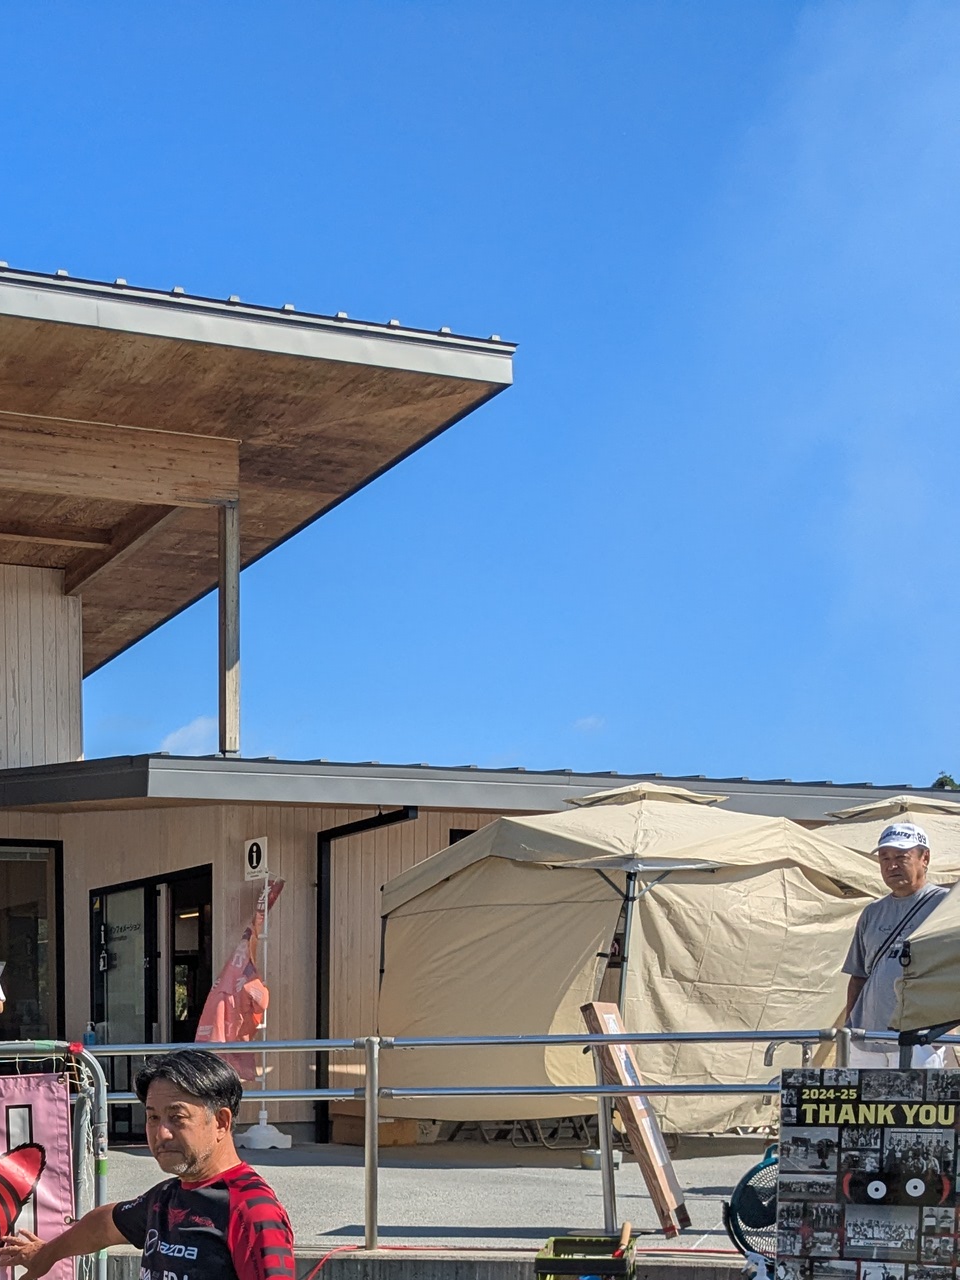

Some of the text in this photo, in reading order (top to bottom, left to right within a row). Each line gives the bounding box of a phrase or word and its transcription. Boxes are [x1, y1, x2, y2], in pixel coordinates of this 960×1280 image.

[802, 1088, 858, 1100] 2024-25
[802, 1103, 955, 1125] THANK YOU
